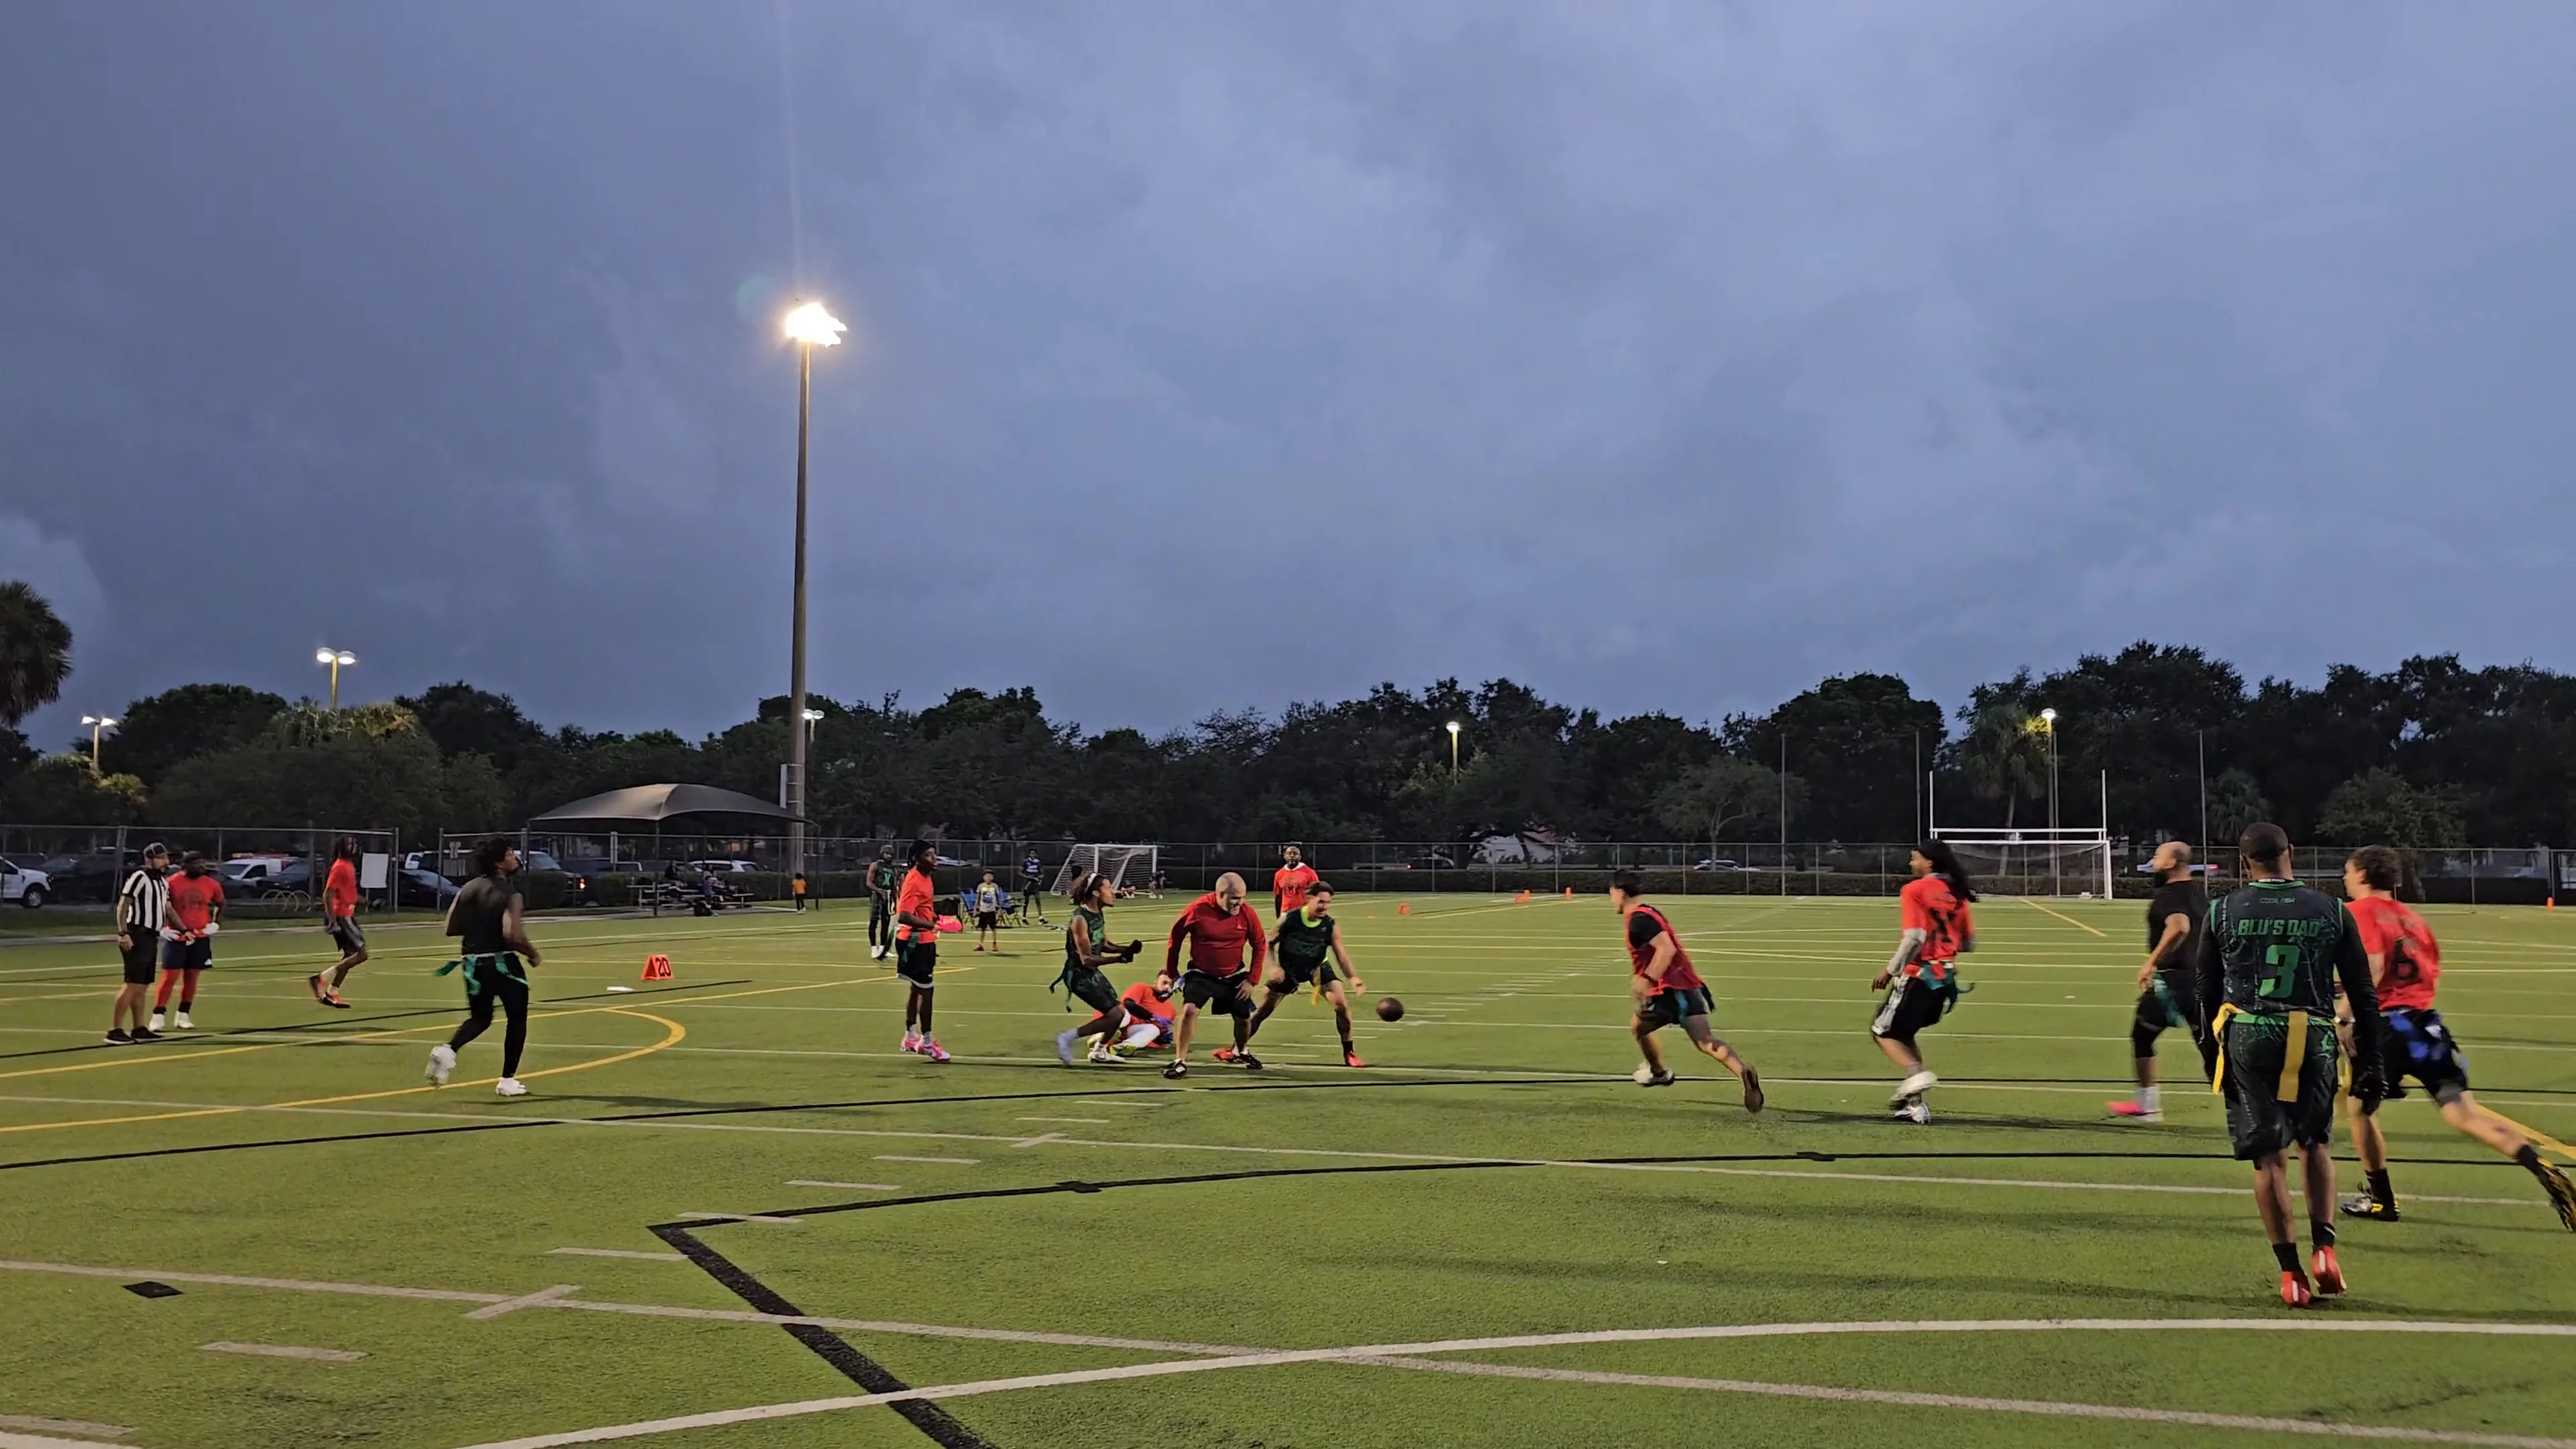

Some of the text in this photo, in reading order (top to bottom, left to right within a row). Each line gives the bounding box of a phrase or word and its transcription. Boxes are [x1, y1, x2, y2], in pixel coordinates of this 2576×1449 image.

[2238, 919, 2320, 937] BLU'S DAD
[655, 957, 671, 977] 20
[2259, 944, 2300, 998] 3
